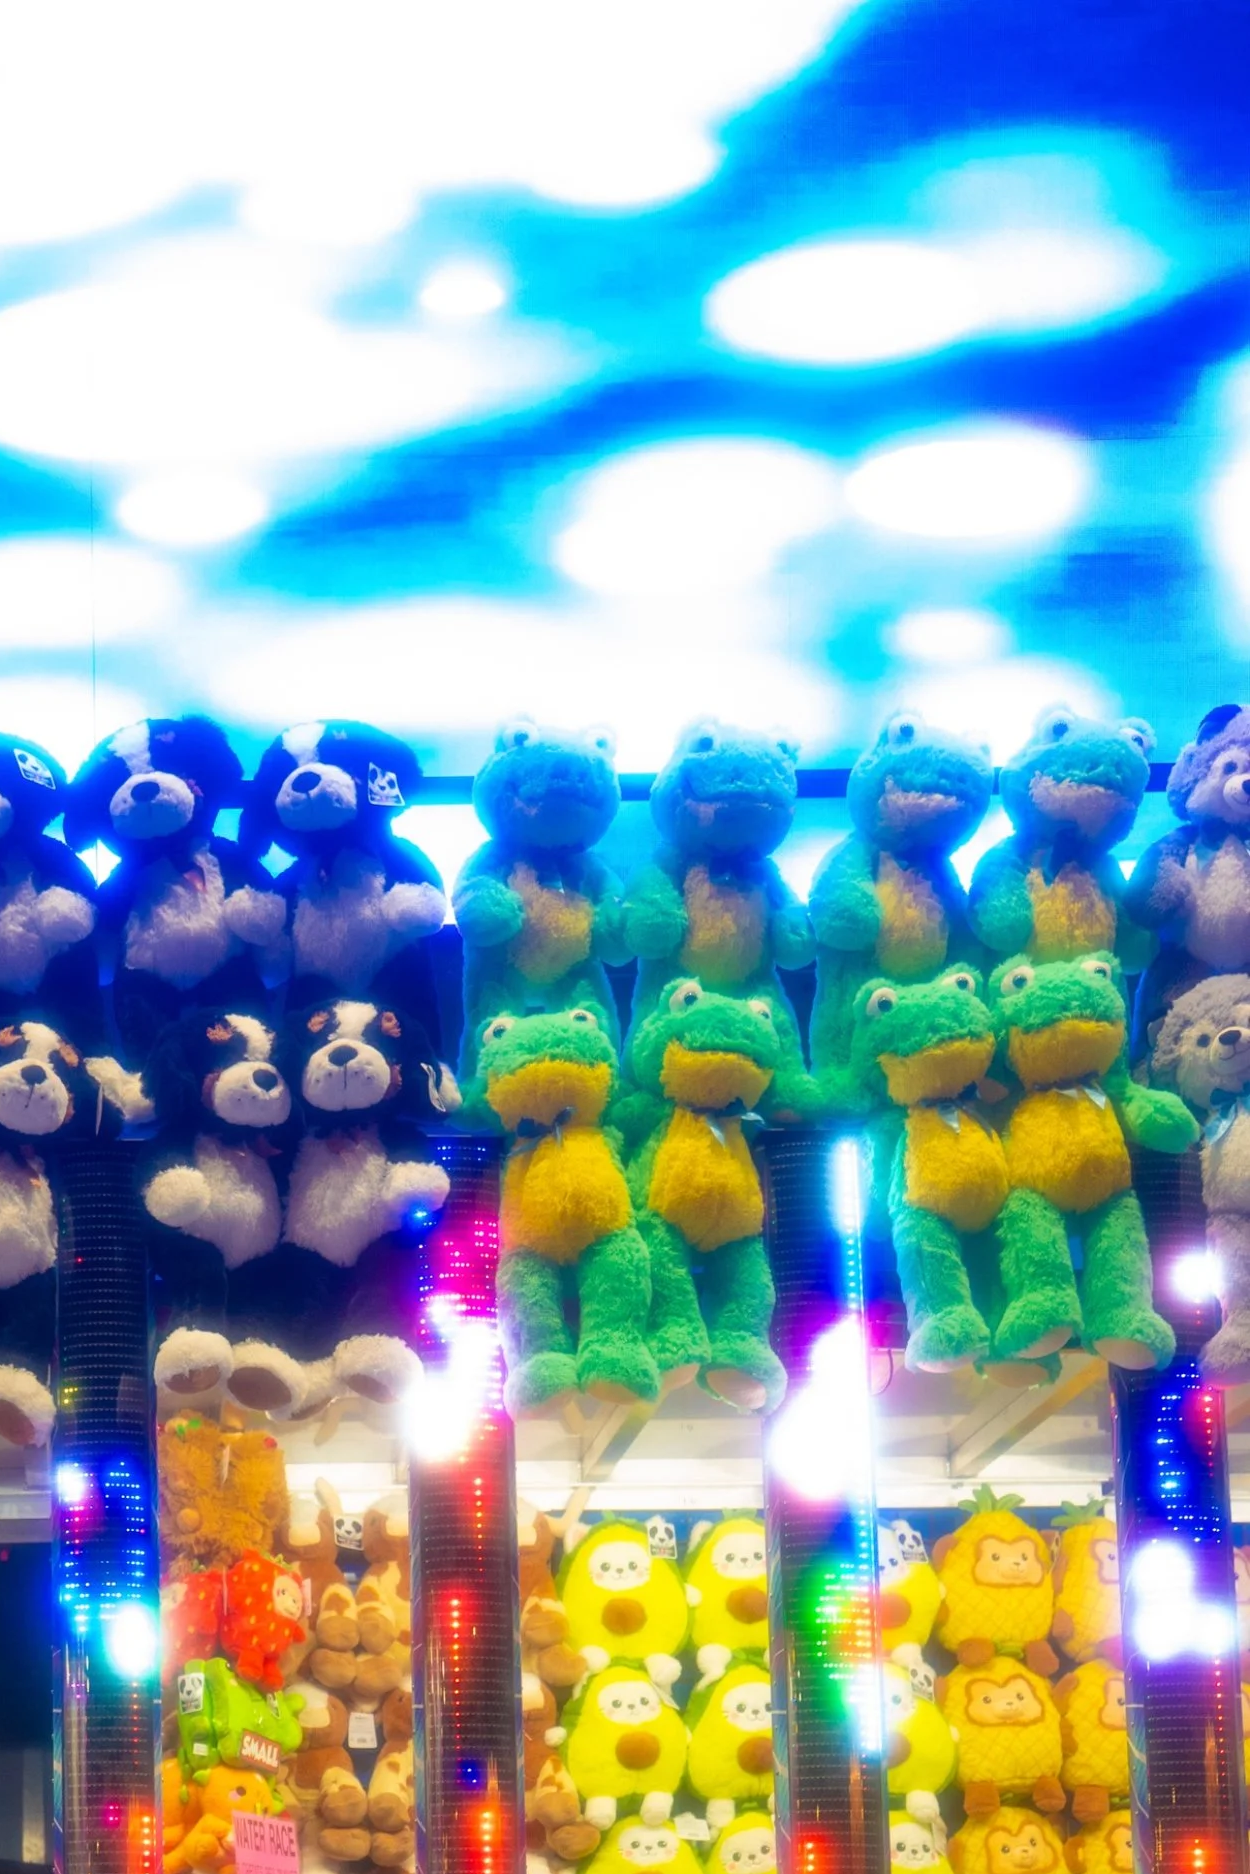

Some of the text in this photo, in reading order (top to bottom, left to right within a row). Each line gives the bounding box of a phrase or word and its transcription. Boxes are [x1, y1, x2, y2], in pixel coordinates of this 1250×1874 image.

[241, 1735, 278, 1768] SMALL
[236, 1817, 296, 1857] WATER RACE
